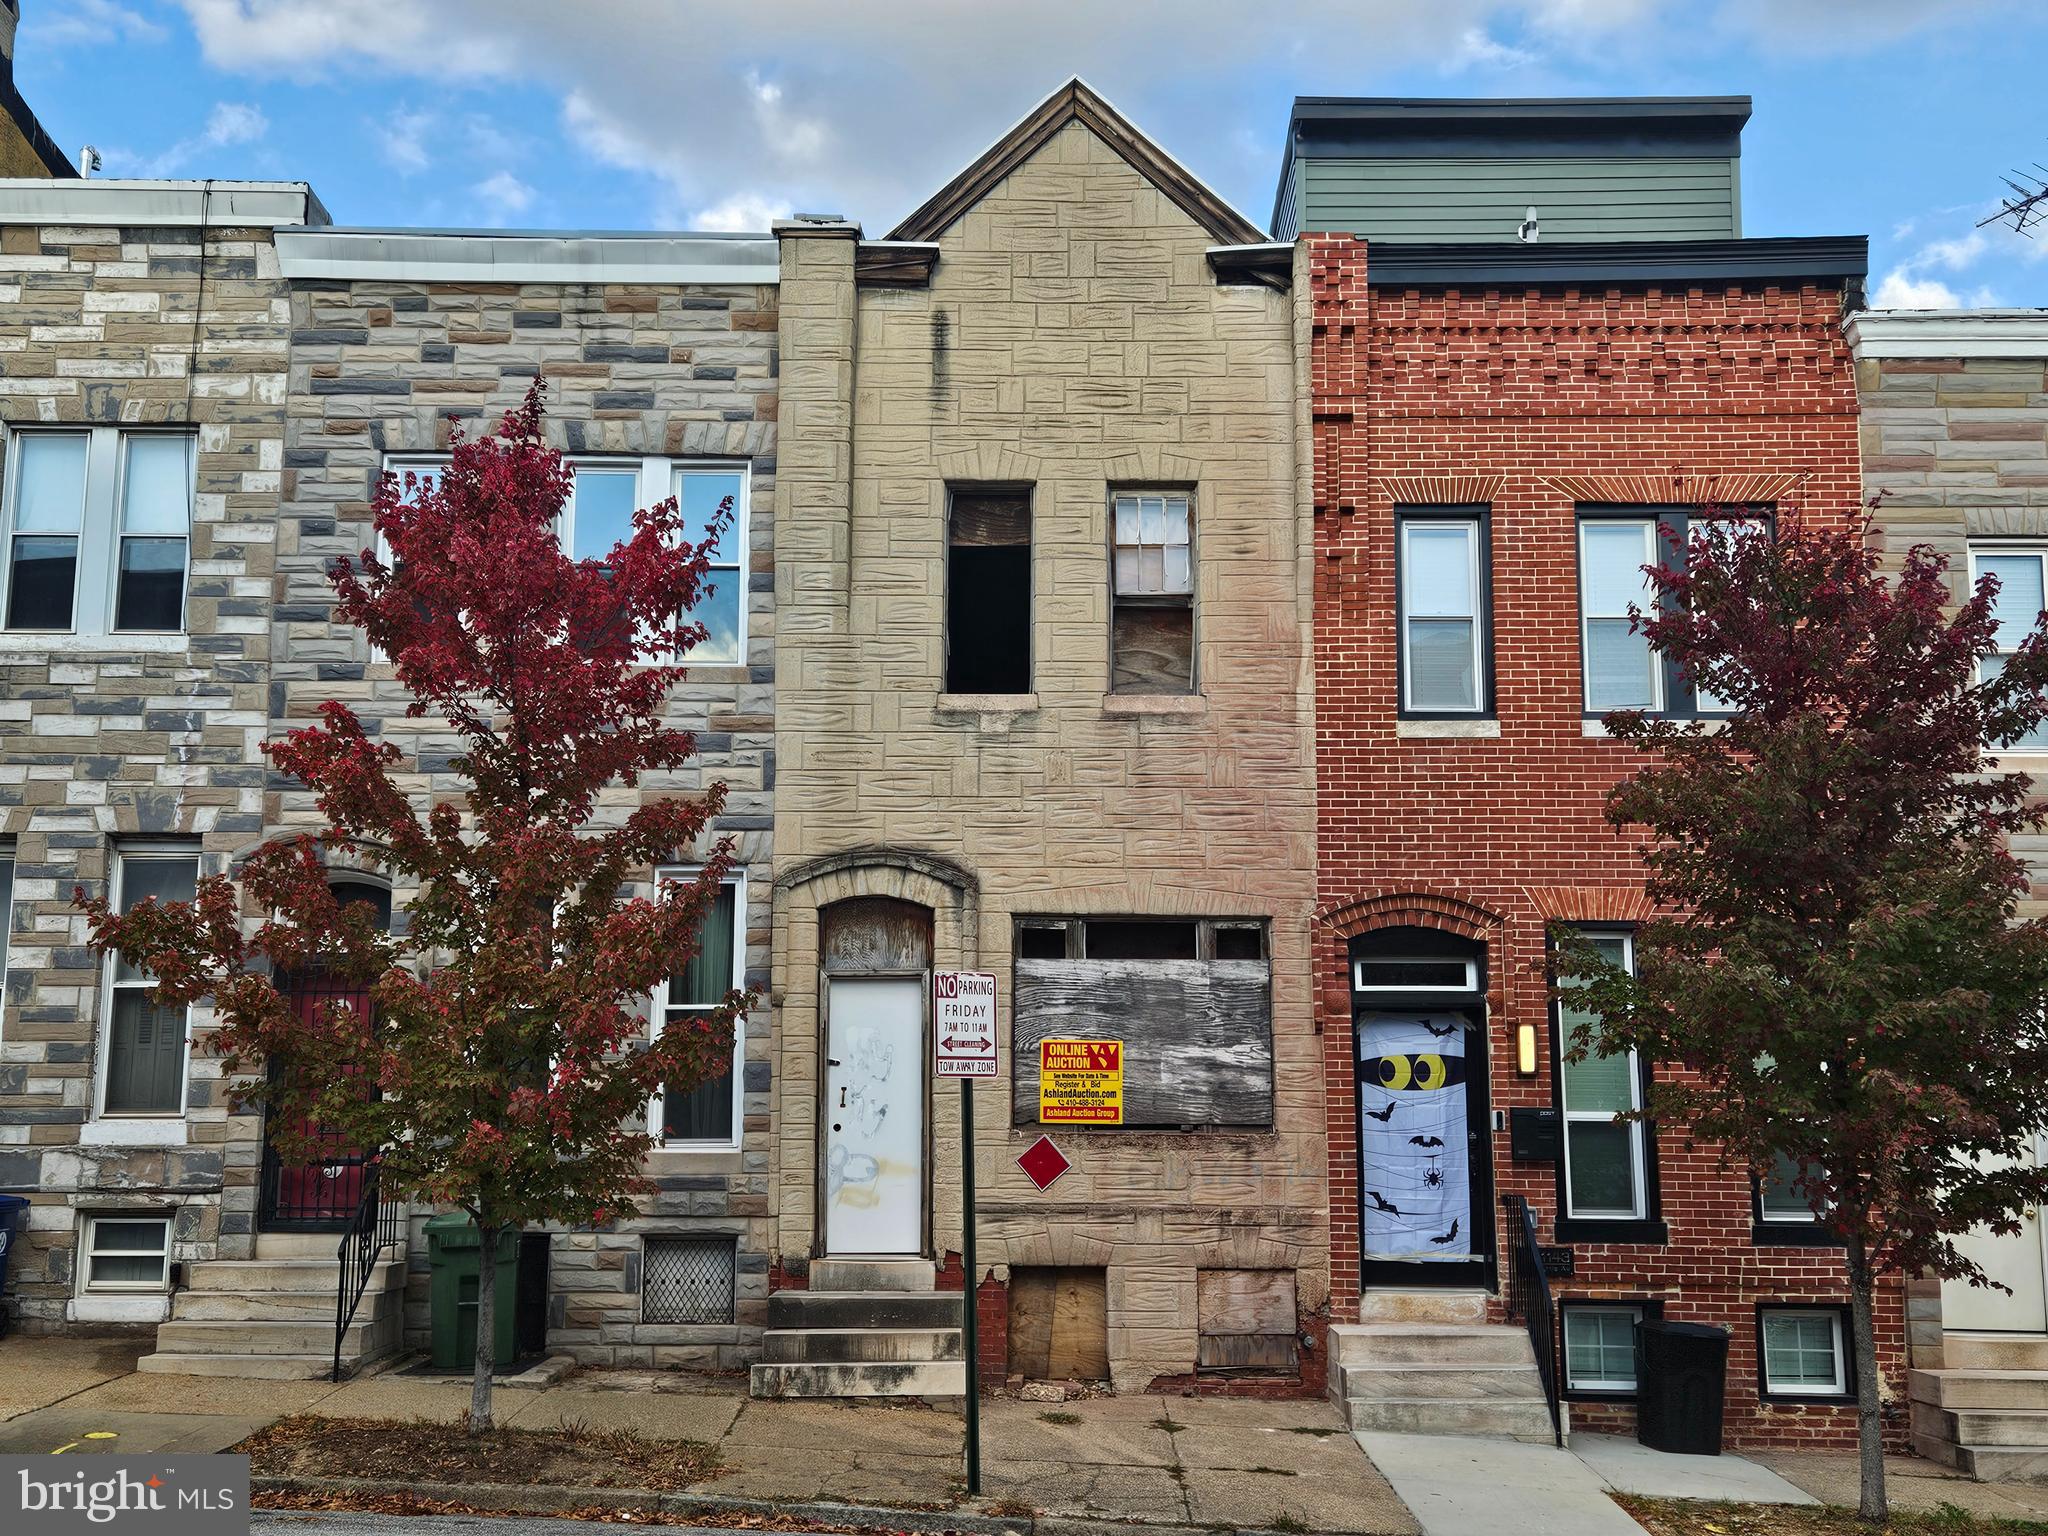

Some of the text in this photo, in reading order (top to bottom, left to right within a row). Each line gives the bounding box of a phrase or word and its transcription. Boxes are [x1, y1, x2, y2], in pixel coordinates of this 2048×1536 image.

[938, 977, 993, 997] NO PARKING
[945, 1004, 986, 1017] FRIDAY
[944, 1022, 988, 1033] 7AM TO 11AM
[1049, 1043, 1088, 1056] ONLINE
[939, 1061, 994, 1073] TOW AWAY ZONE
[1046, 1057, 1091, 1069] AUCTION
[1055, 1080, 1101, 1089] Register & Bid
[1043, 1088, 1117, 1099] AshlandAuction.com
[1046, 1108, 1115, 1119] Ashland Auction Group
